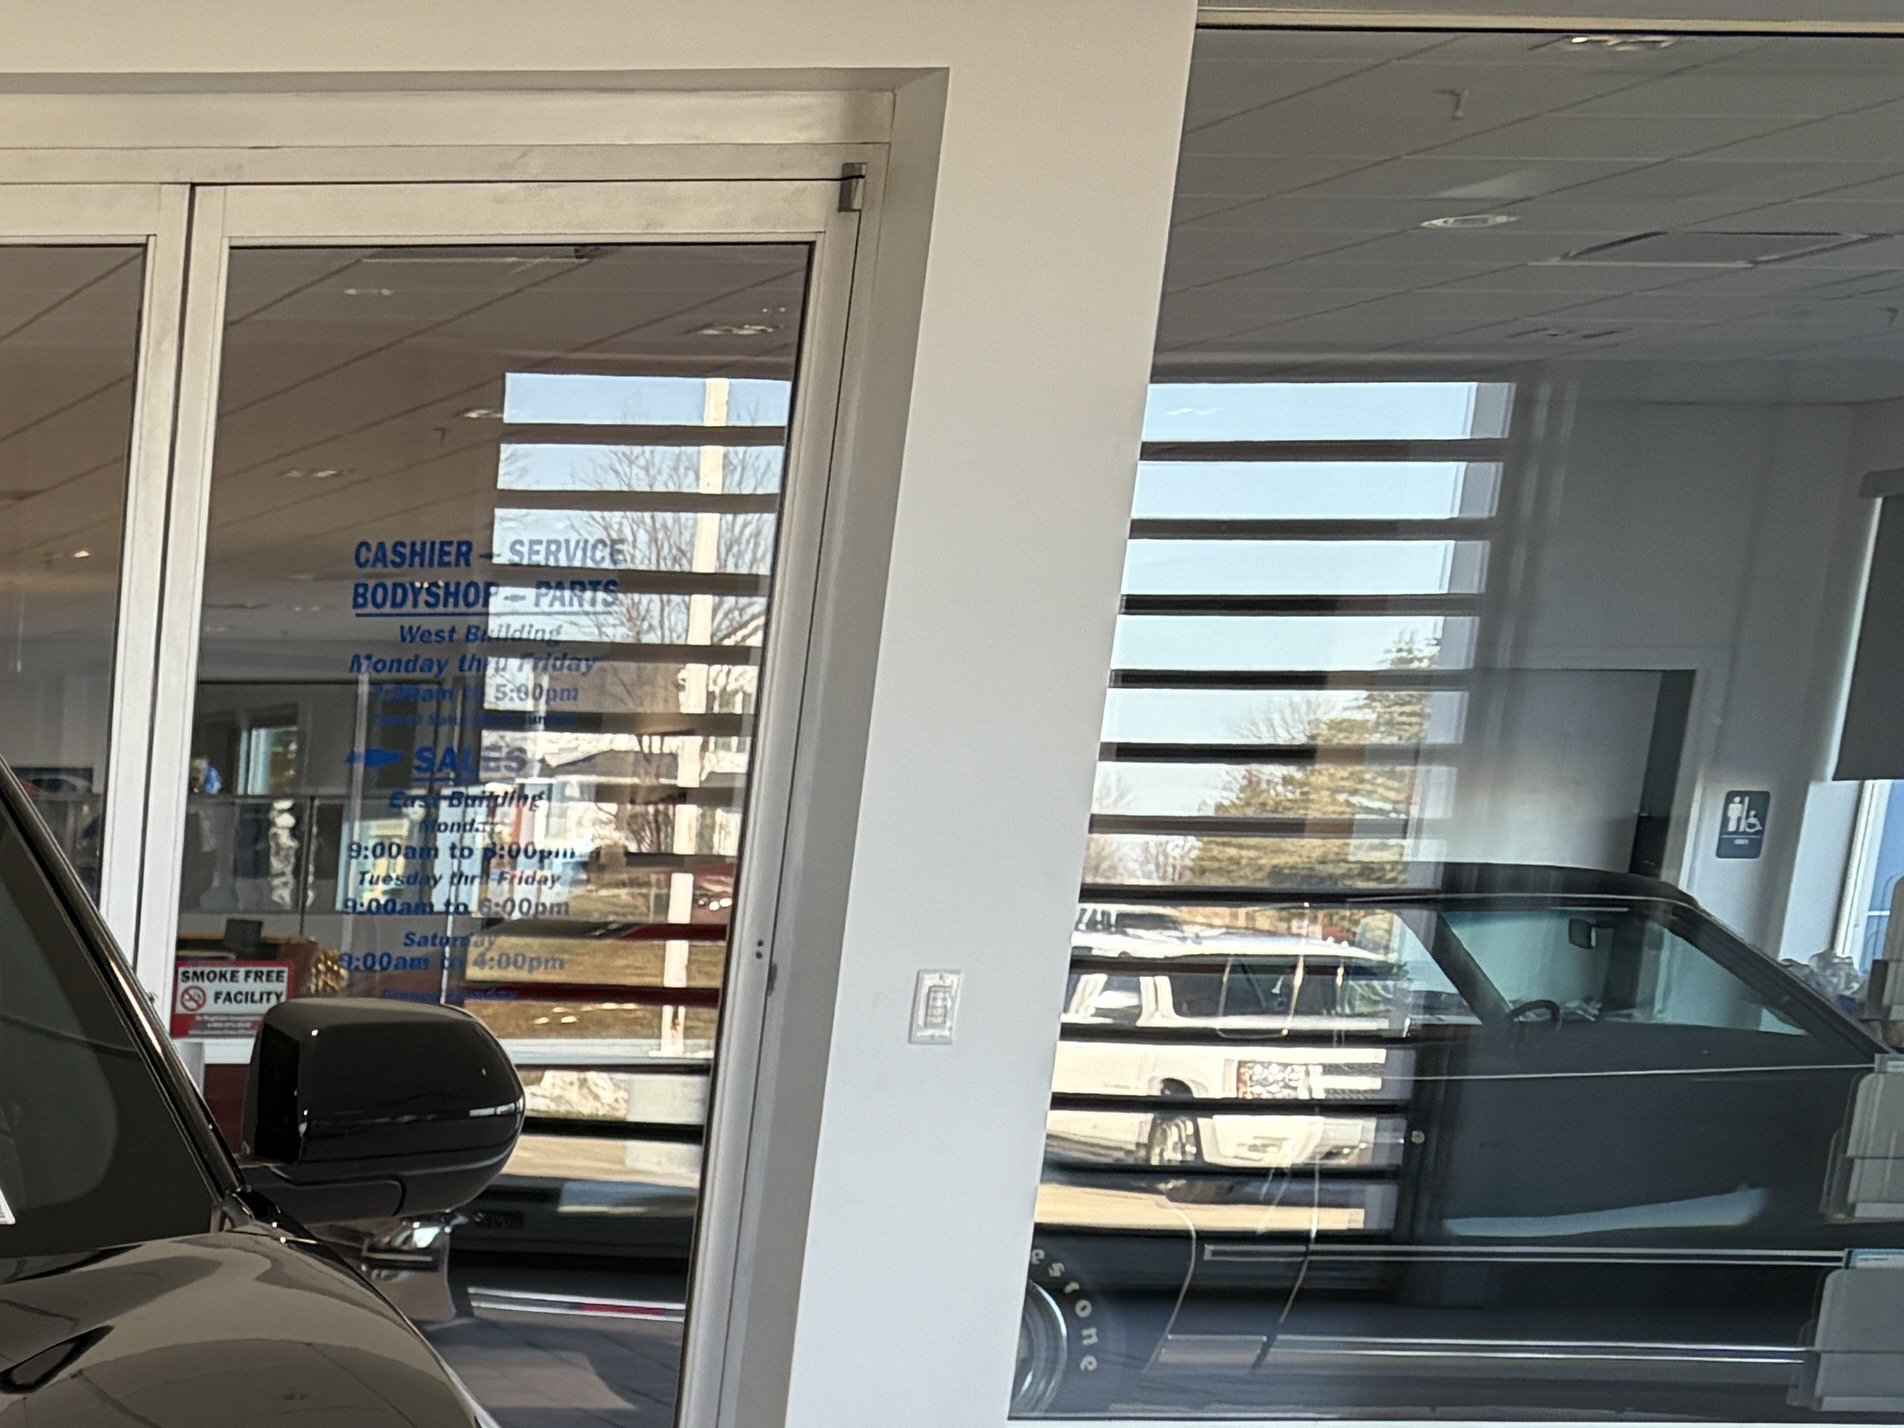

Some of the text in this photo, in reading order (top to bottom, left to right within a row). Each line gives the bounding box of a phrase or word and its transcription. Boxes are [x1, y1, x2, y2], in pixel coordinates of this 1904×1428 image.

[354, 538, 626, 569] CASHIER SERVICE
[352, 578, 621, 610] BODYSHOP PARTS
[399, 622, 564, 648] West Building
[349, 651, 597, 677] Monday thru Friday
[494, 682, 580, 706] 5:00pm
[412, 745, 528, 774] SALES
[390, 789, 439, 809] East
[347, 841, 439, 860] 9:00am
[449, 841, 474, 860] to
[358, 870, 562, 889] Tuesday thr Friday
[343, 897, 570, 919] 9:00am to 6:00pm
[403, 931, 497, 952] Saturday
[472, 951, 567, 974] 4:00pm
[180, 969, 285, 983] SMOKE FREE
[213, 990, 284, 1005] FACILITY
